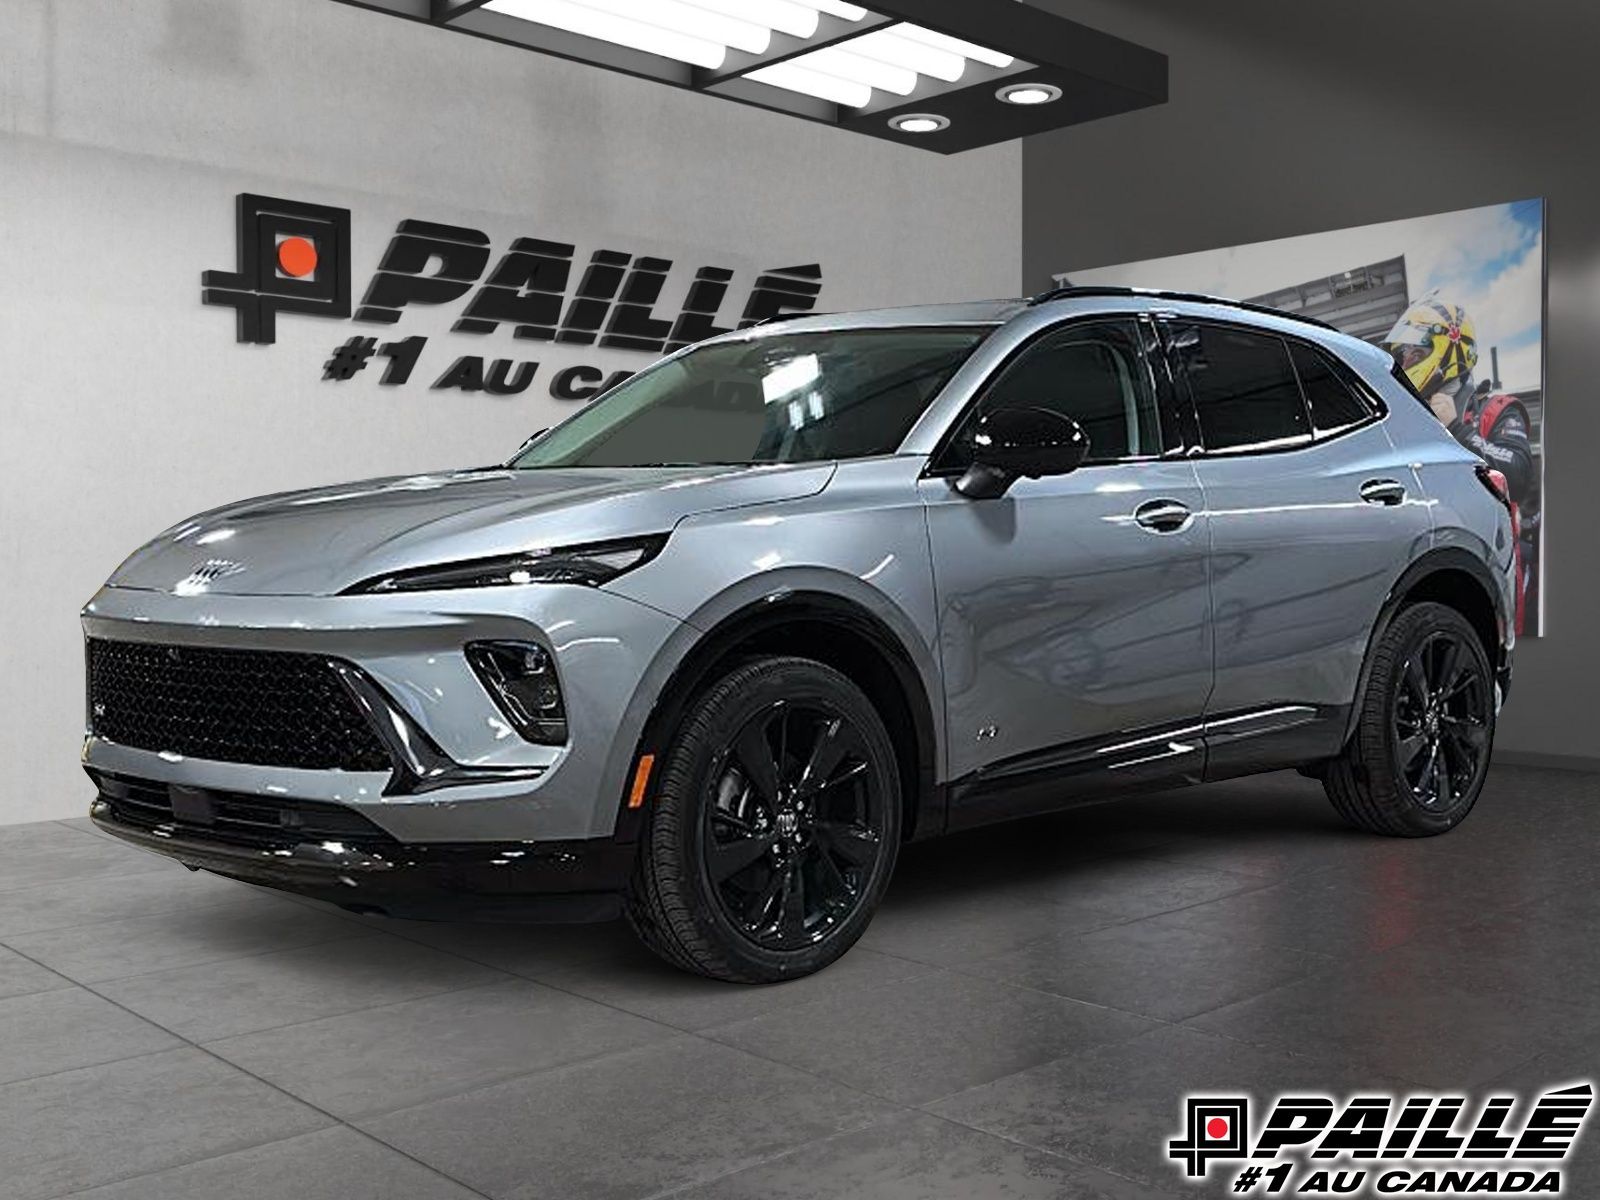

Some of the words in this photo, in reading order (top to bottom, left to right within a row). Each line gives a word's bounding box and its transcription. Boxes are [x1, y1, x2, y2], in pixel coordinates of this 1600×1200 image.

[352, 218, 822, 355] PAILLÉ
[321, 336, 428, 386] #1
[429, 356, 540, 396] AU
